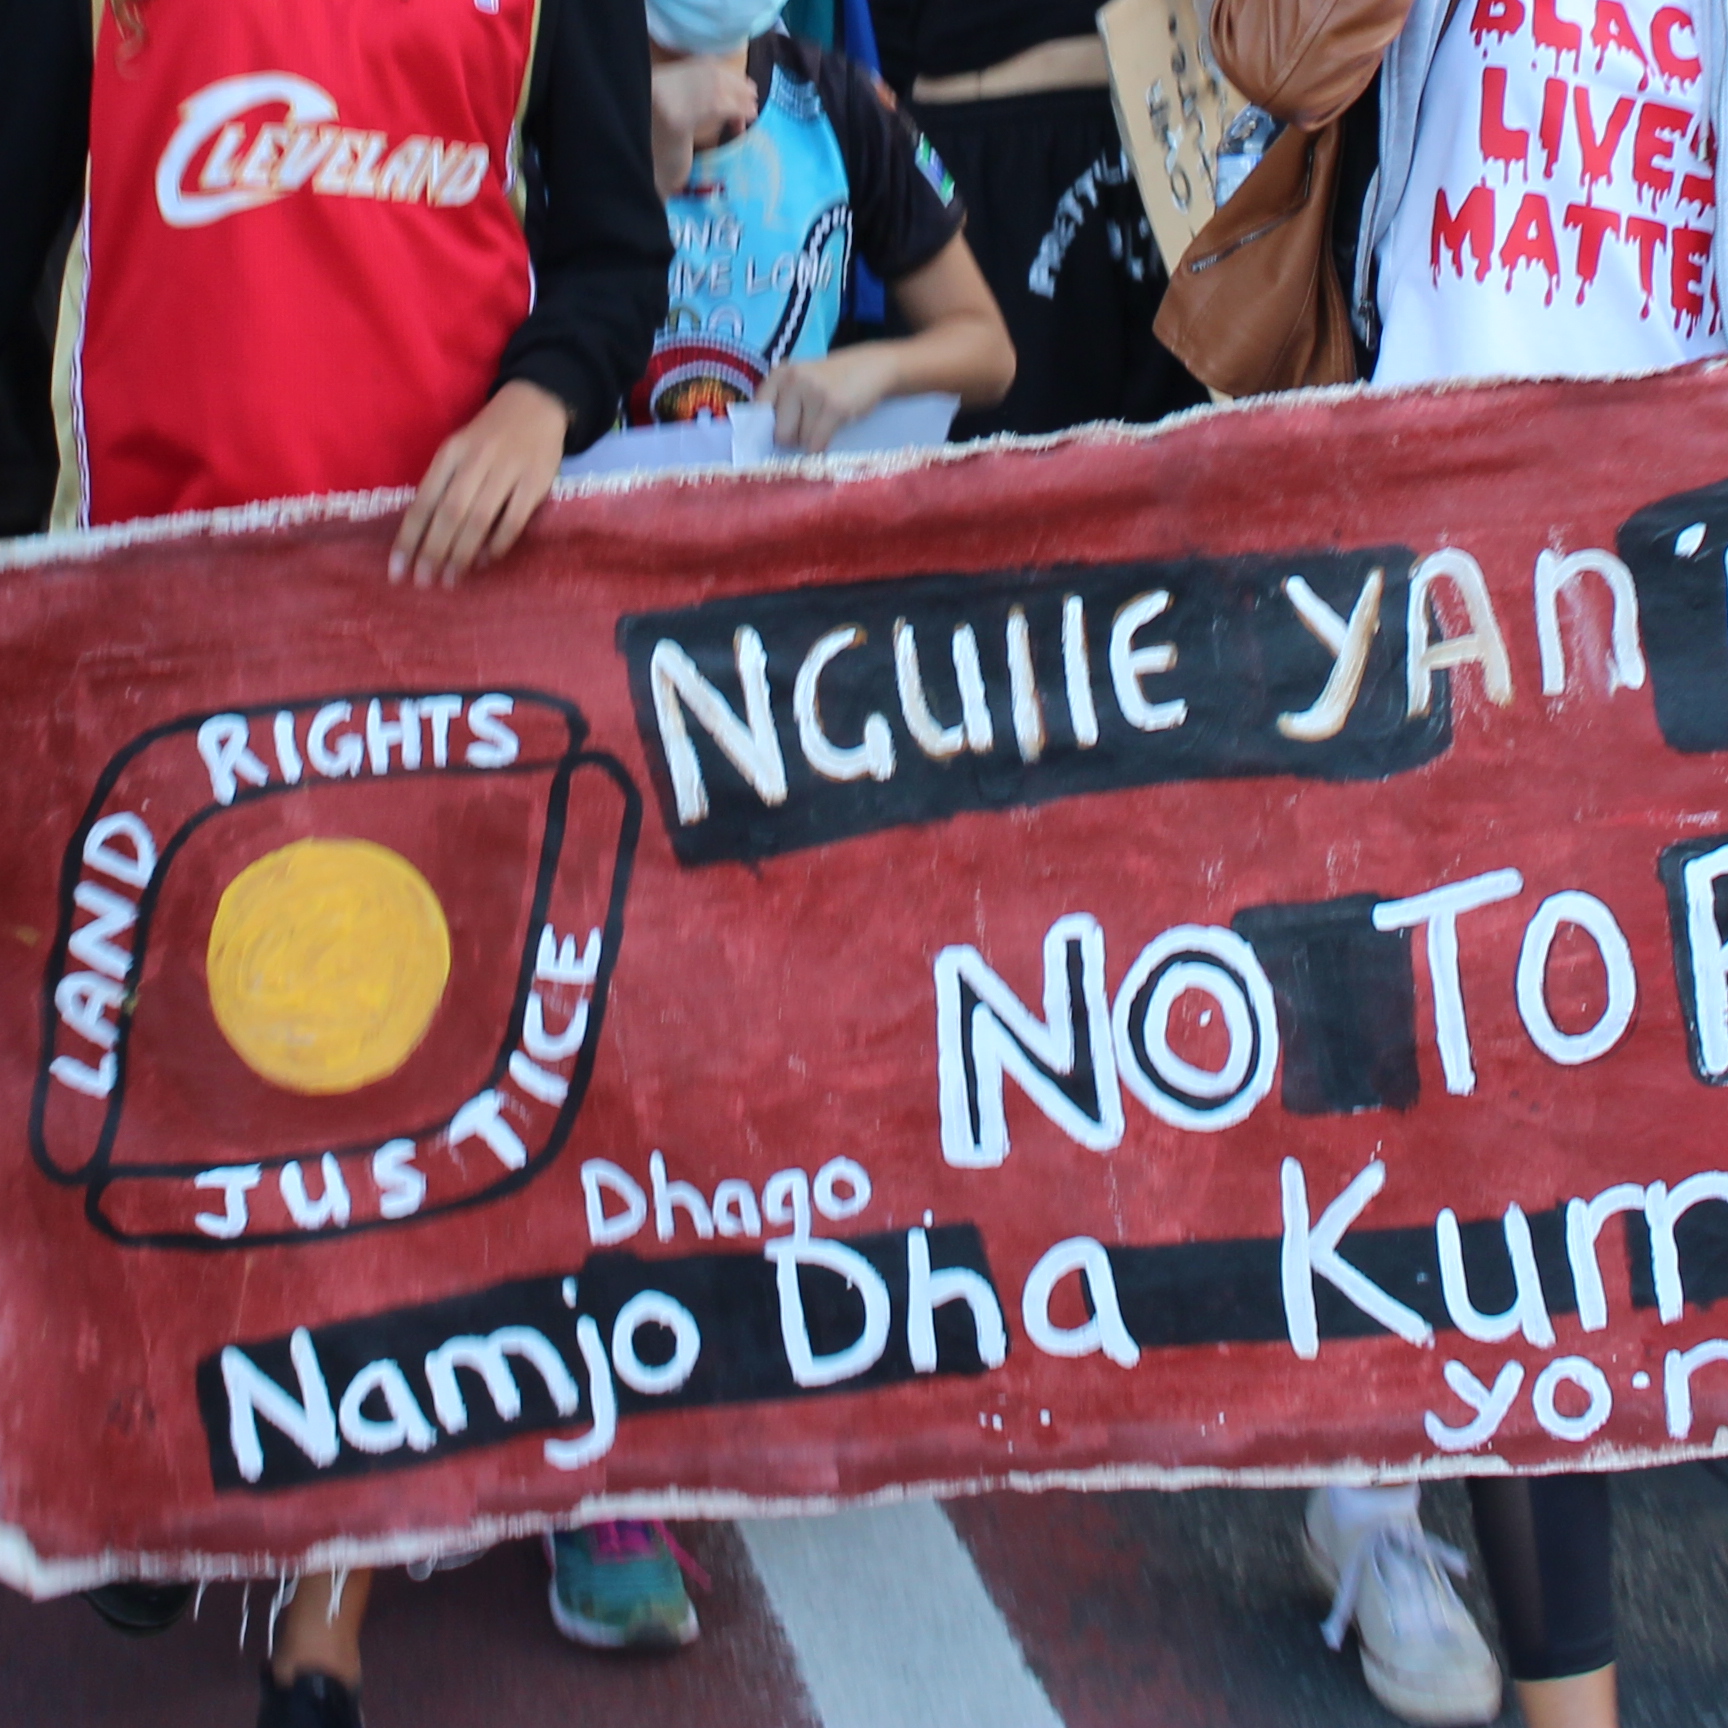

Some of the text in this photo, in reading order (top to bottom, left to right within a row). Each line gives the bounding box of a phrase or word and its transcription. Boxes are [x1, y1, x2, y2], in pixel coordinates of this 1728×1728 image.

[155, 70, 489, 229] CLEVELAND
[1429, 180, 1724, 339] MATTE
[49, 693, 521, 1098] LAND RIGHTS
[932, 911, 1279, 1169] NO
[1371, 868, 1638, 1096] TO
[192, 923, 603, 1239] JUSTICE
[220, 1274, 702, 1484] Namjo
[765, 1228, 1141, 1387] Dha
